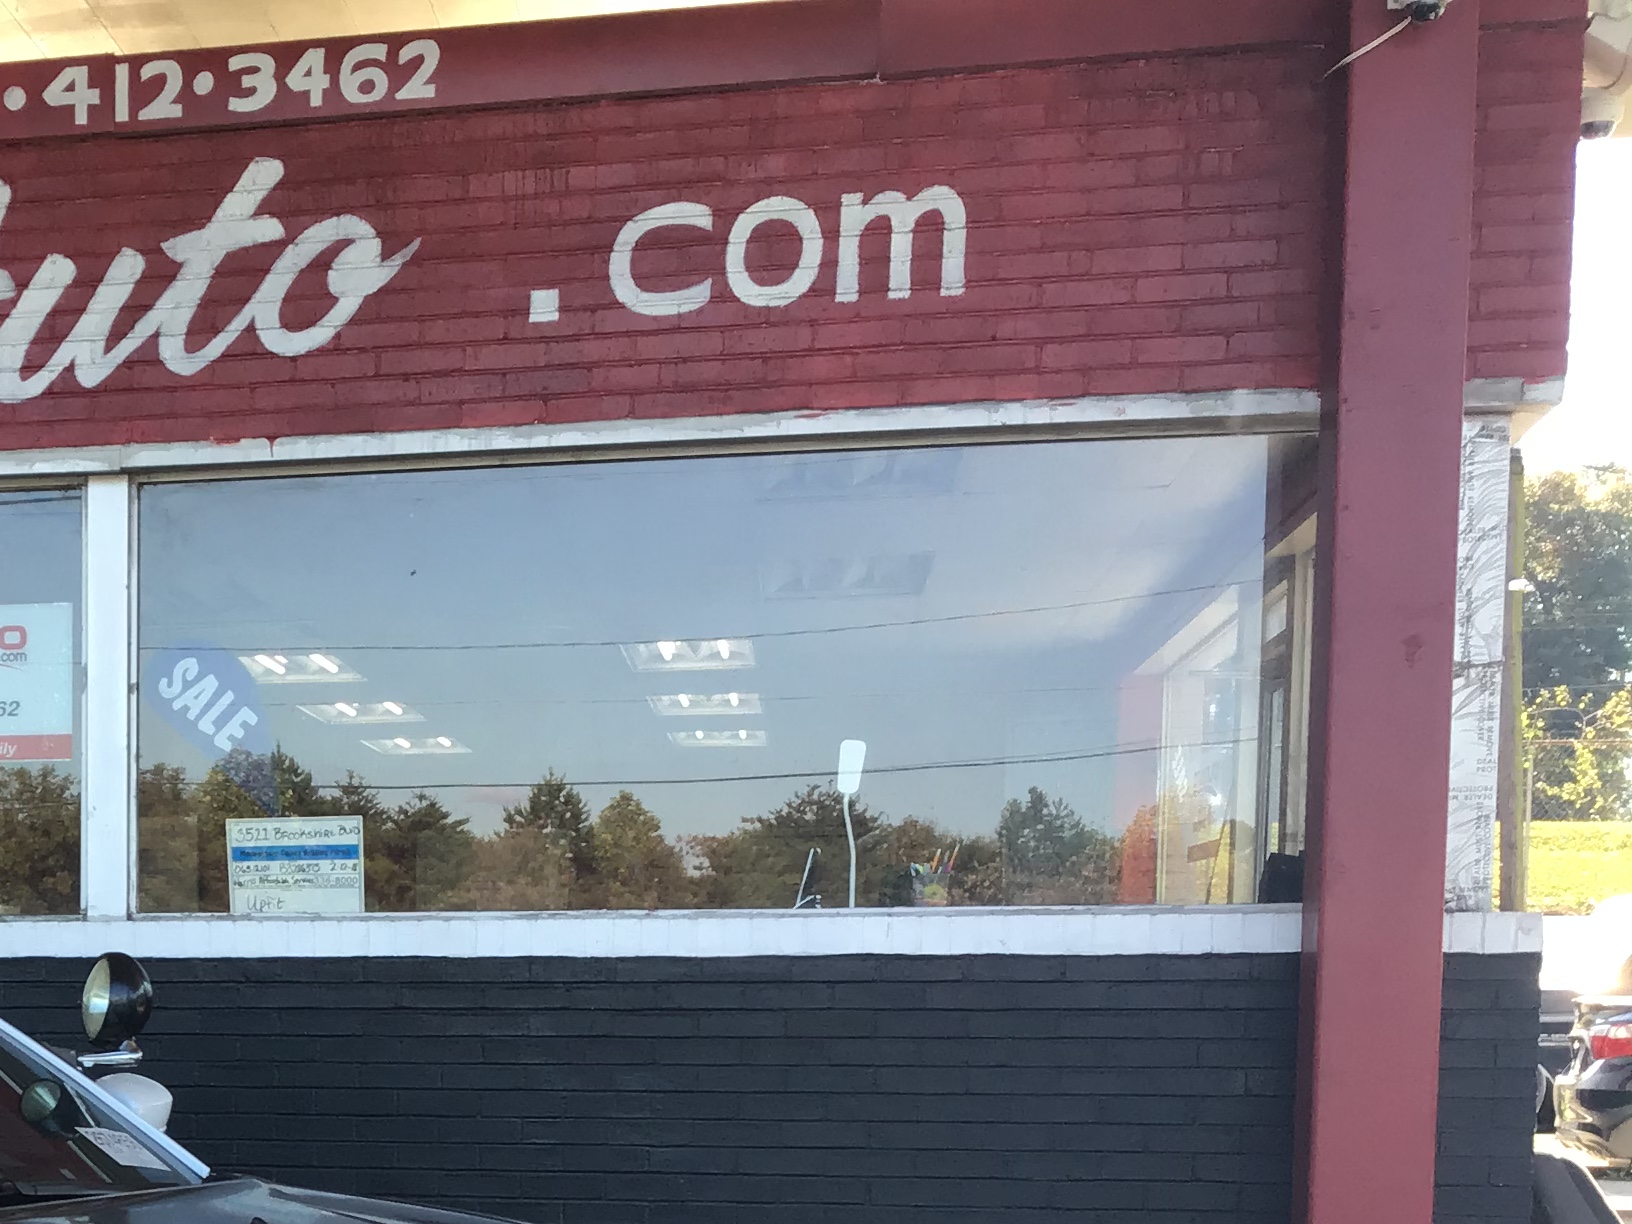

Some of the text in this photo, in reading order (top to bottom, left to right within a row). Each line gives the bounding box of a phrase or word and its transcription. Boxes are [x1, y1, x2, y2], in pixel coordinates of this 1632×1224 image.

[528, 184, 967, 323] .com
[158, 657, 259, 751] SALE
[235, 827, 270, 843] 3521
